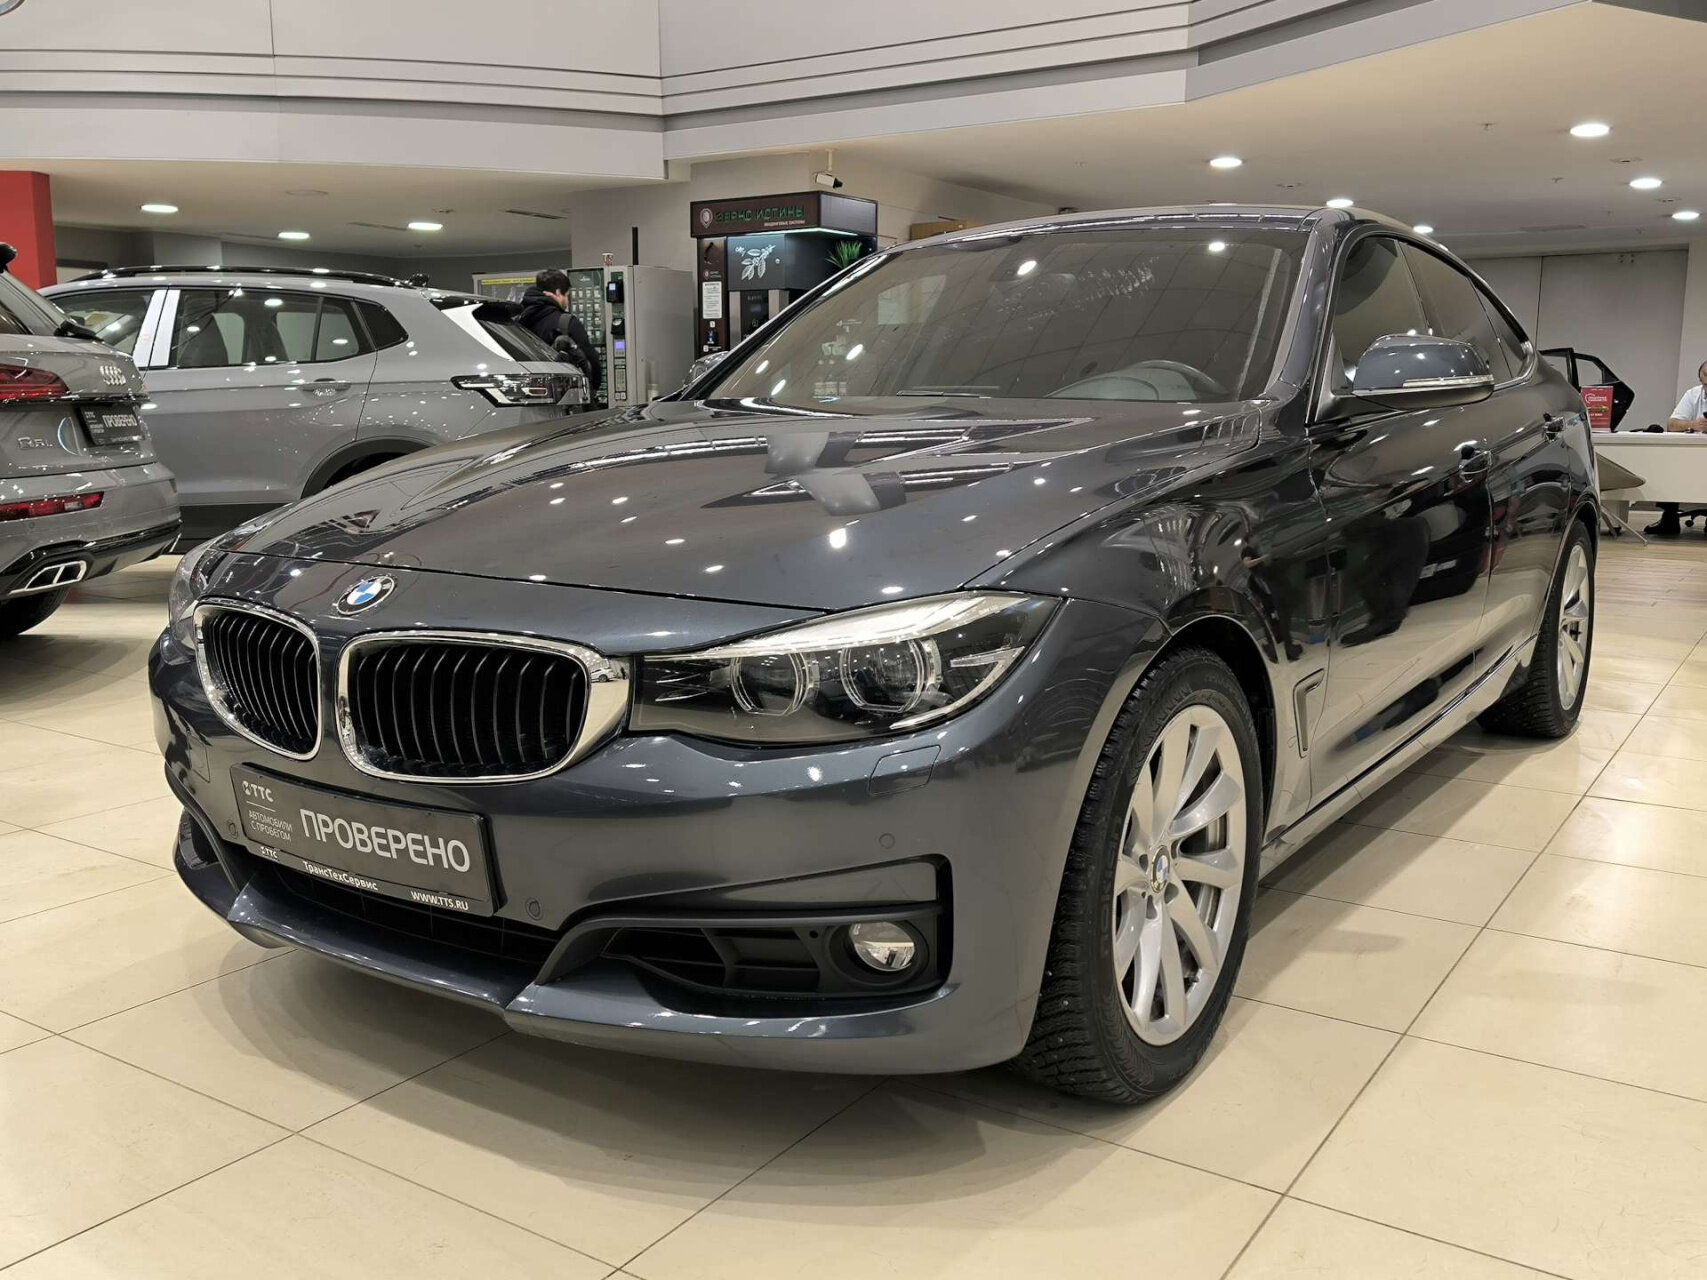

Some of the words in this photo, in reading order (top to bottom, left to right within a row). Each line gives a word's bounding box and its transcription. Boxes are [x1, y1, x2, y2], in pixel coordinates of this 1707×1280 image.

[102, 413, 138, 428] ПРОВЕРЕНО
[249, 810, 293, 832] АВТОМОБИЛИ
[300, 808, 471, 873] ПРОВЕРЕНО
[302, 860, 378, 891] ТрансТехСервис
[411, 891, 469, 911] WWW.TTS.RU
